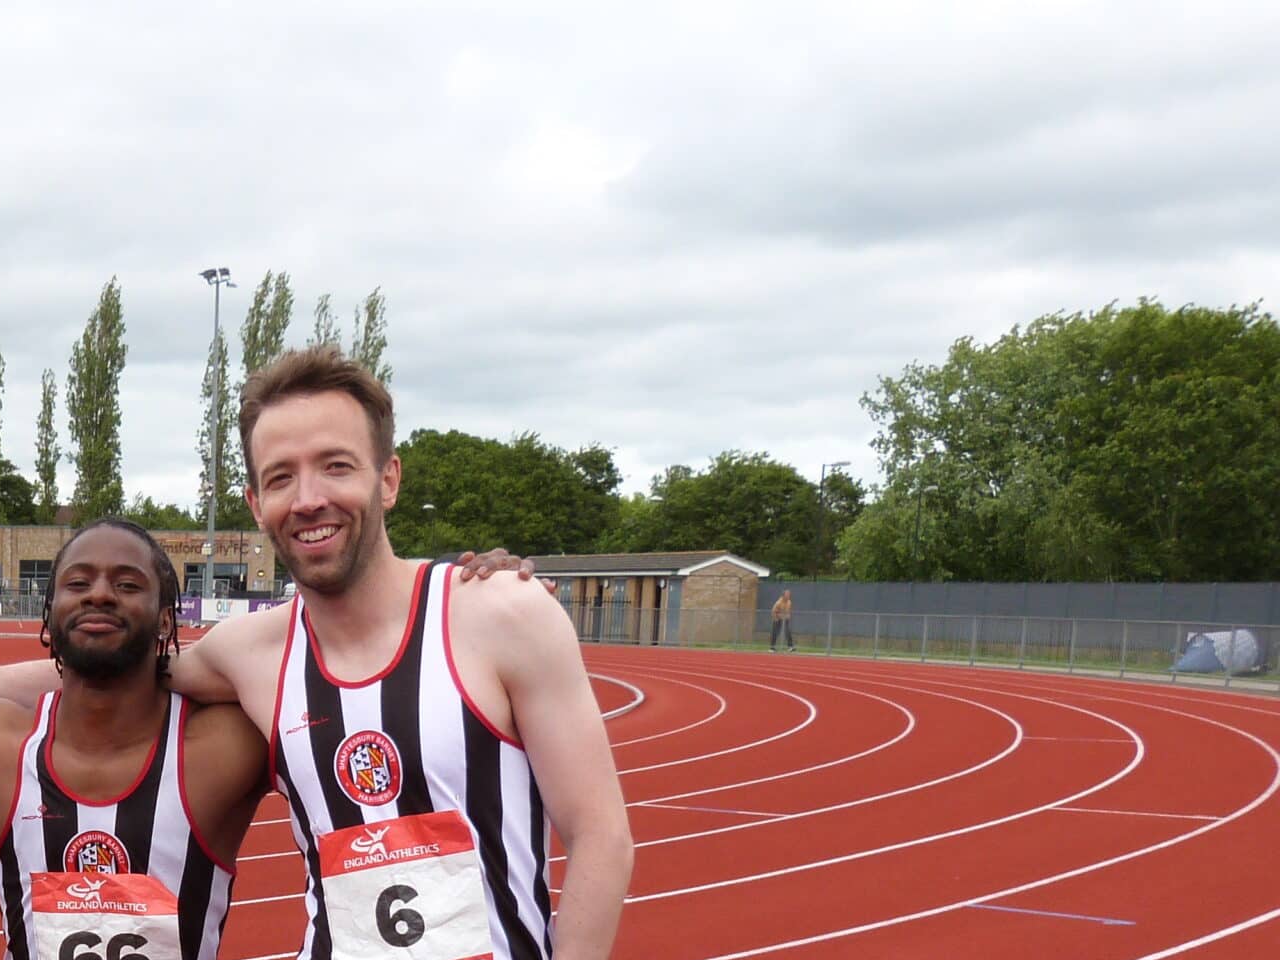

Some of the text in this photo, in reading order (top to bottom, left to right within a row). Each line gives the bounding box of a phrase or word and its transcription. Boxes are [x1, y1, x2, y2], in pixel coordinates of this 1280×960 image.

[343, 843, 440, 870] ENGLAND ATHLETICS
[57, 900, 148, 913] ENGLAND ATHLETICS
[375, 884, 425, 948] 6
